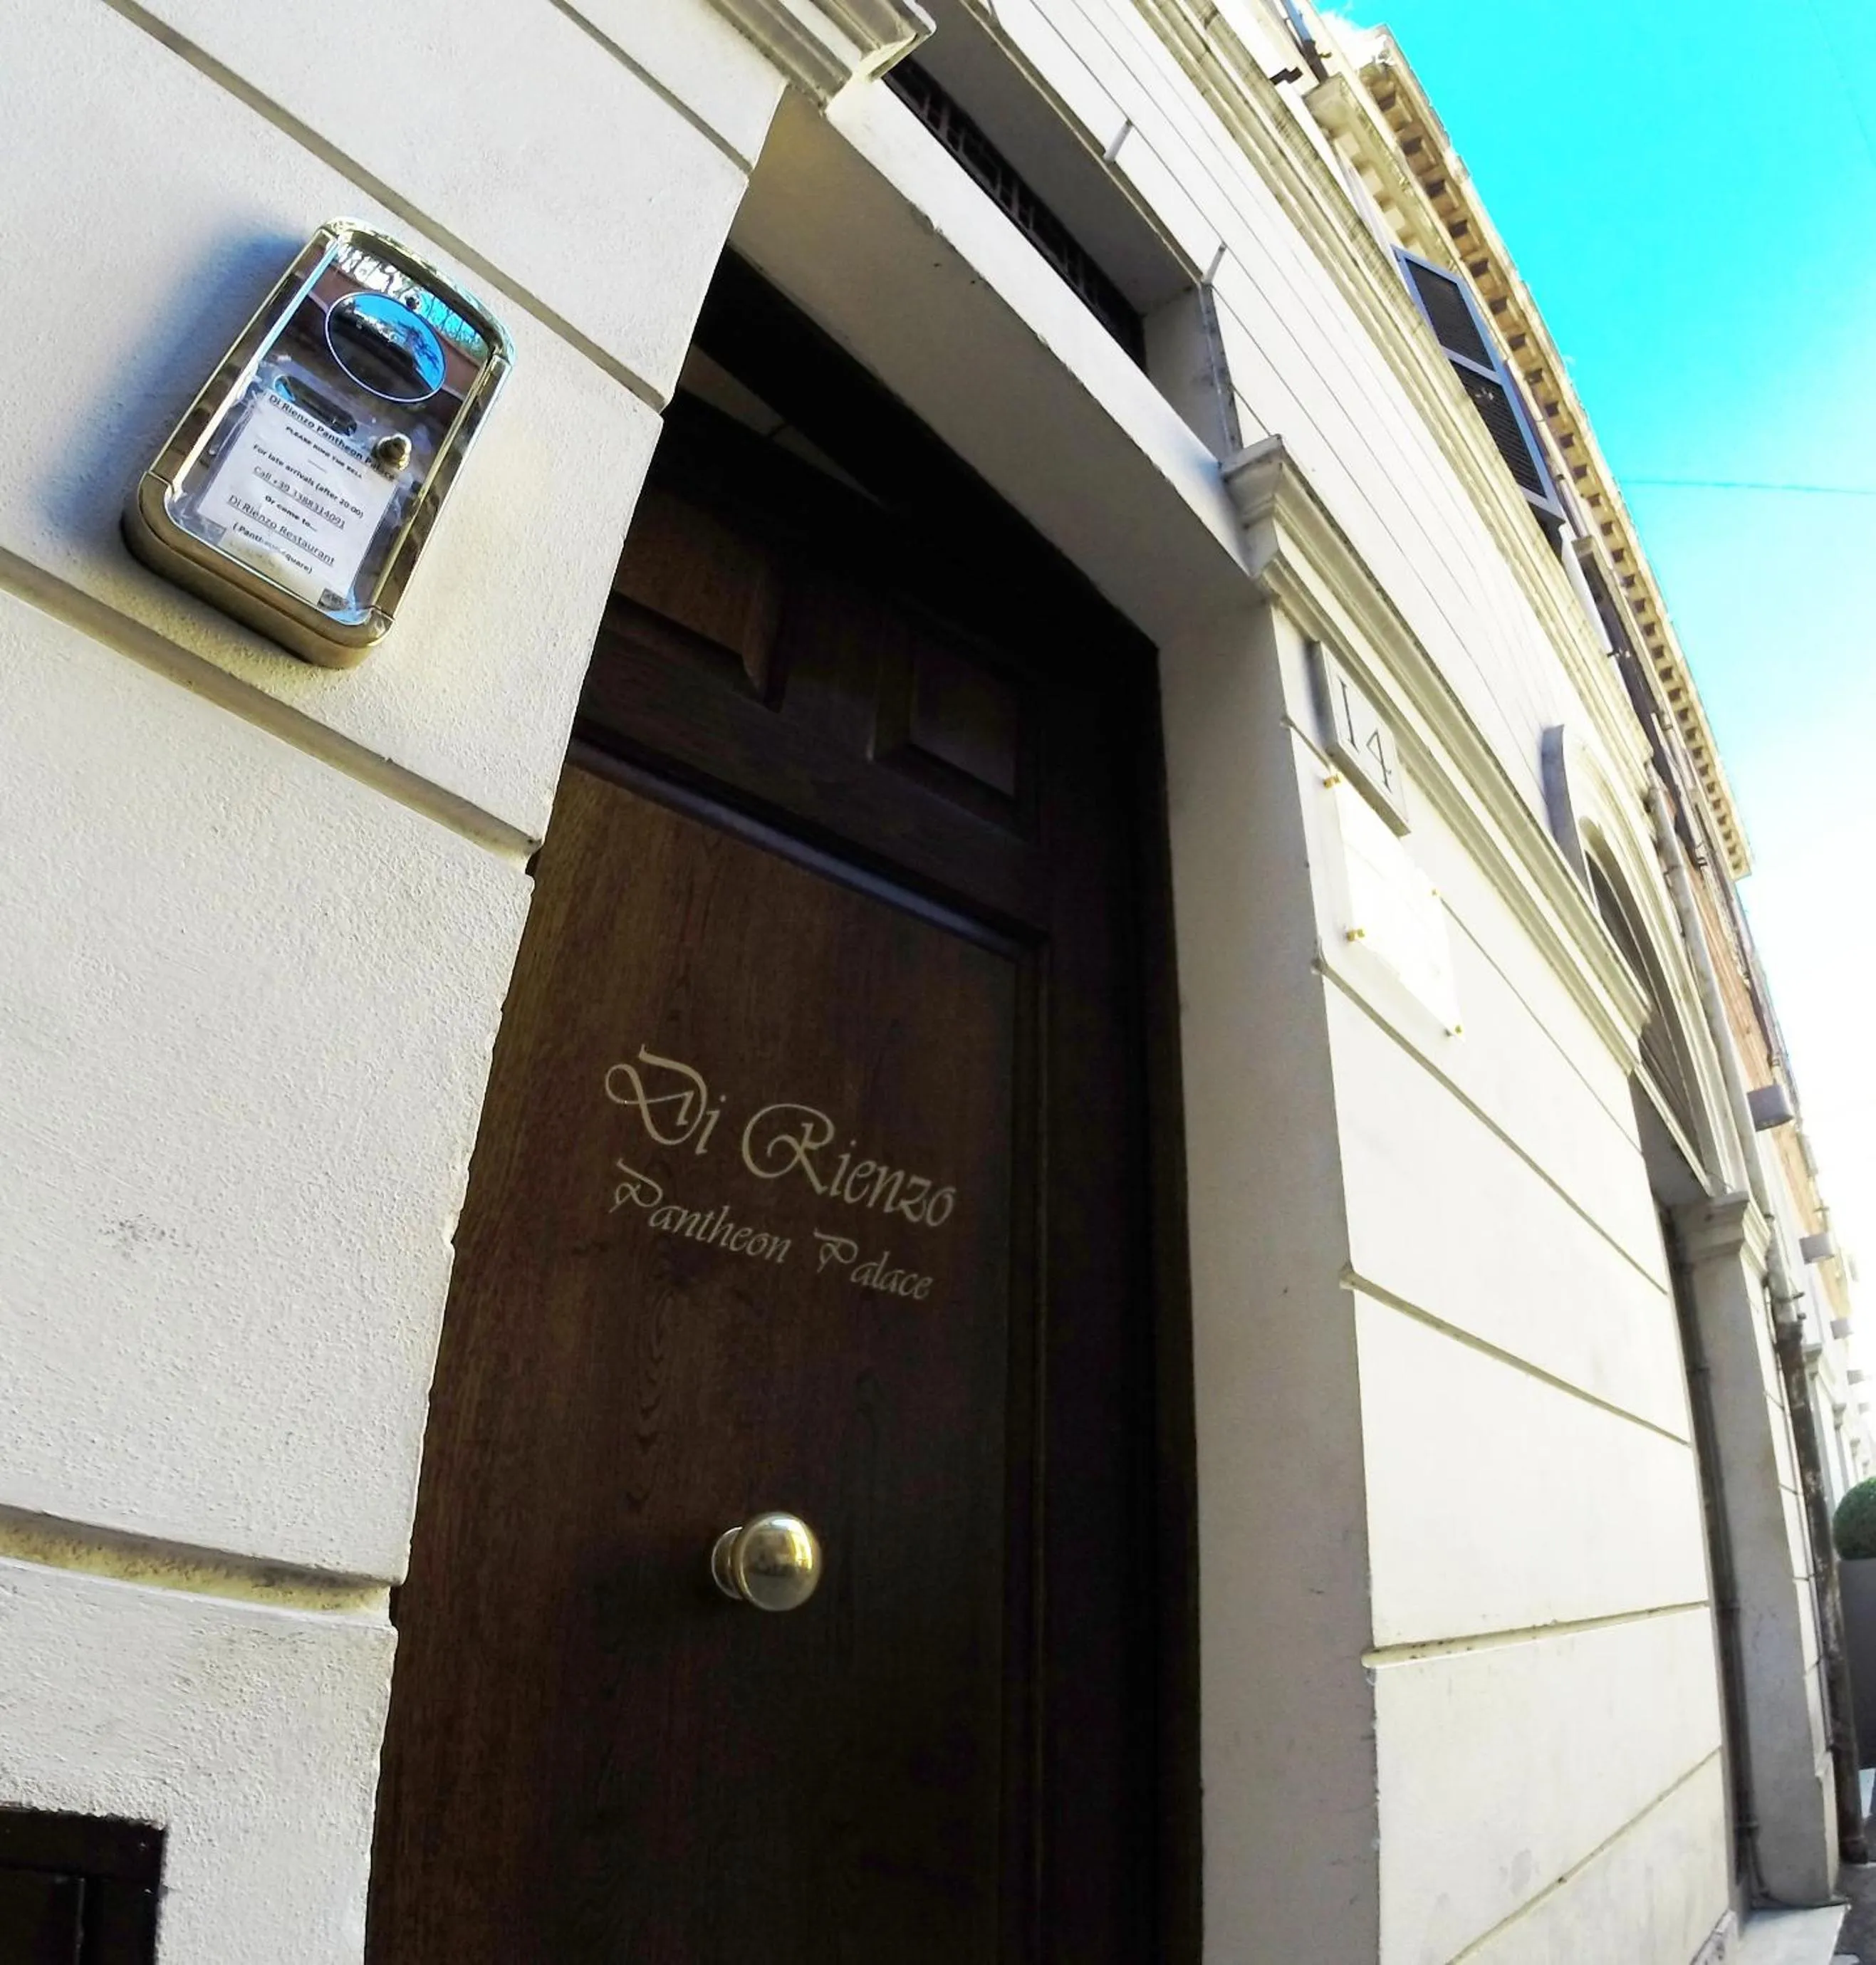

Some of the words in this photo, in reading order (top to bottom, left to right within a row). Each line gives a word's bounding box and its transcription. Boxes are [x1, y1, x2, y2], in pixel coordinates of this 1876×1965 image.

[269, 395, 282, 405] Di
[282, 403, 315, 428] Rienzo
[317, 426, 363, 460] Pantheon
[253, 443, 267, 456] For
[268, 453, 284, 466] late
[286, 465, 314, 486] arrivals
[315, 483, 338, 500] (after
[254, 466, 272, 481] Call
[228, 494, 241, 509] Di
[243, 502, 278, 531] Rienzo
[279, 526, 335, 565] Restaurant
[265, 495, 276, 505] Or
[276, 503, 300, 521] come
[280, 548, 313, 575] quare)
[605, 1043, 726, 1155] Di
[742, 1103, 957, 1227] Rienzo
[608, 1157, 792, 1263] Pantheon
[813, 1226, 934, 1301] Palace
